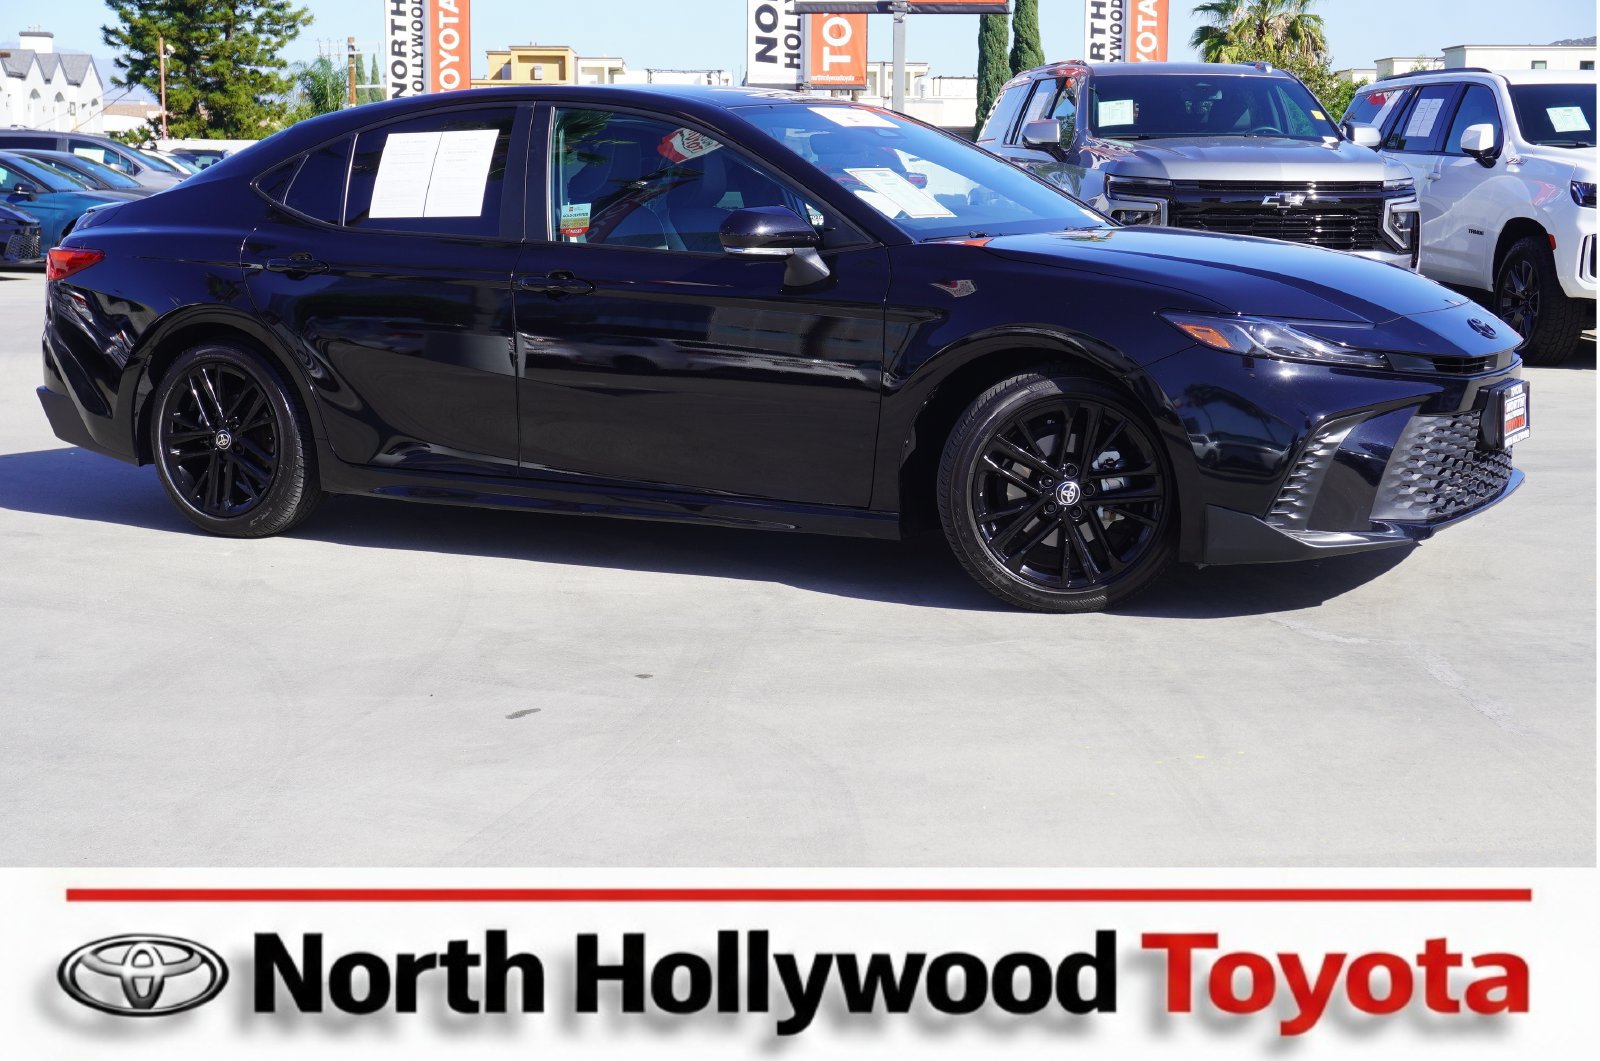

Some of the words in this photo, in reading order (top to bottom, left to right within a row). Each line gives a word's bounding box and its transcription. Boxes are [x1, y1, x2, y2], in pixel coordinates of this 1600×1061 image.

[390, 0, 408, 100] NORTH
[411, 0, 425, 97] OLLYWOO
[438, 0, 460, 94] OYOTA
[755, 0, 779, 64] NO
[822, 13, 852, 71] TO
